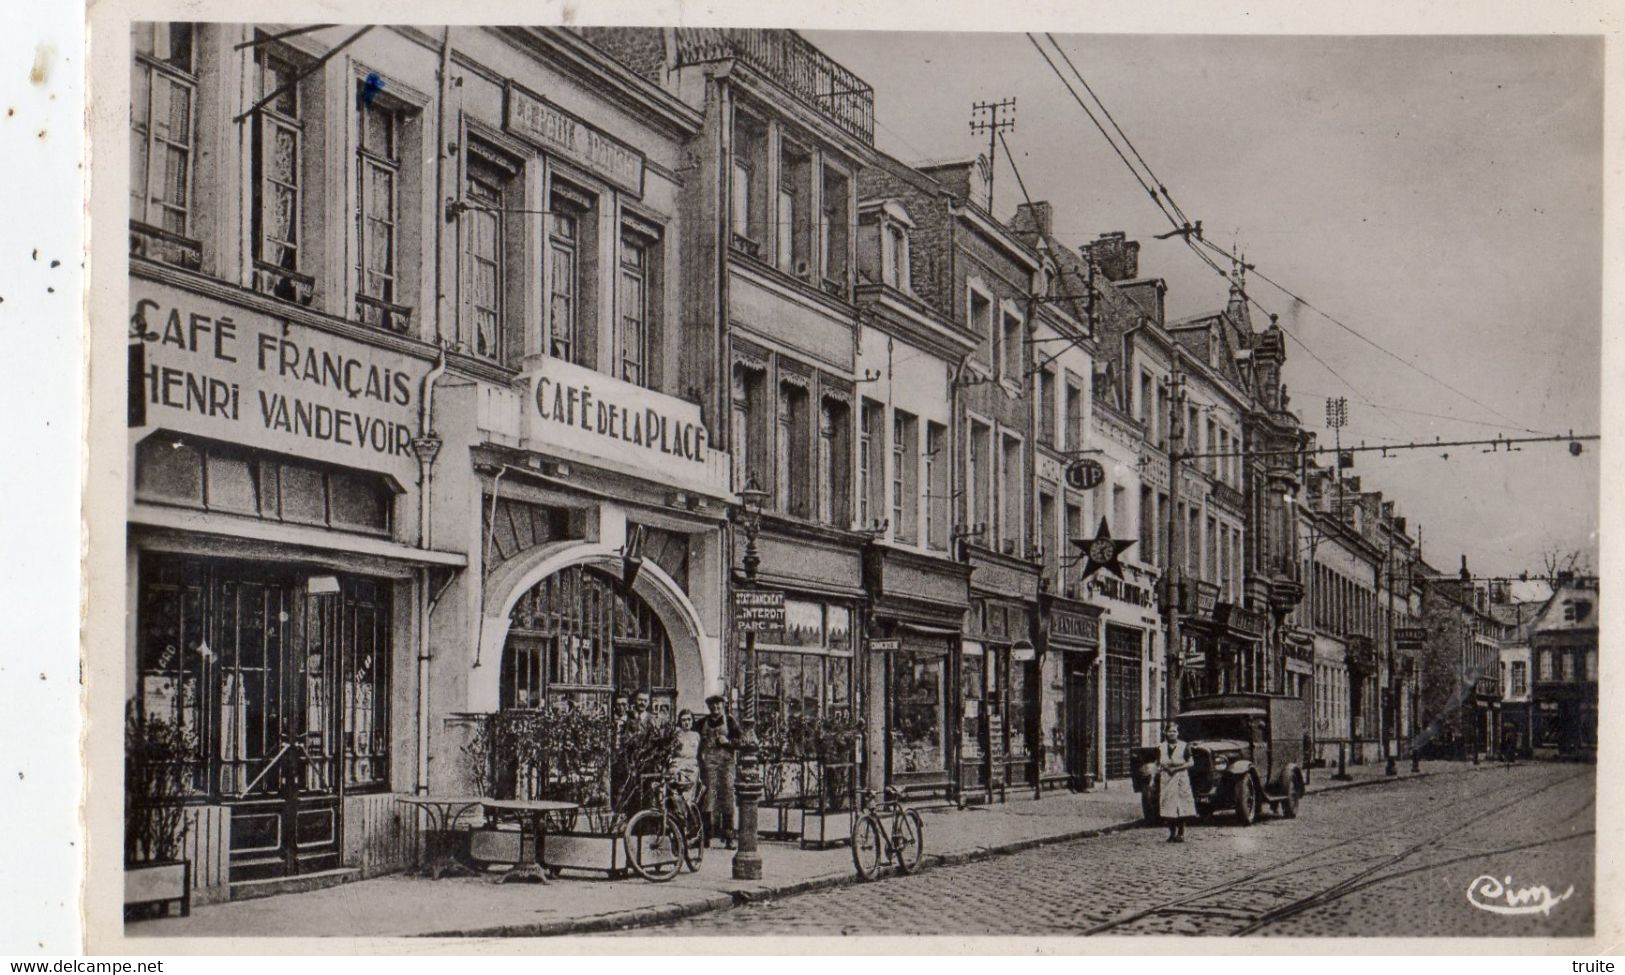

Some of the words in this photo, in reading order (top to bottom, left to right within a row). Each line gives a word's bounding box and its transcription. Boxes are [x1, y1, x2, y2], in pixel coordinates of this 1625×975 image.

[131, 298, 237, 363] CAFÉ
[258, 332, 411, 407] FRANÇAIS
[258, 390, 414, 458] VANDEVOIR
[536, 376, 593, 431] CAFÉ
[597, 400, 619, 439] DE
[622, 408, 643, 446] LA
[646, 407, 706, 463] PLACE
[1070, 465, 1101, 486] LIP
[743, 608, 785, 620] INTERDIT
